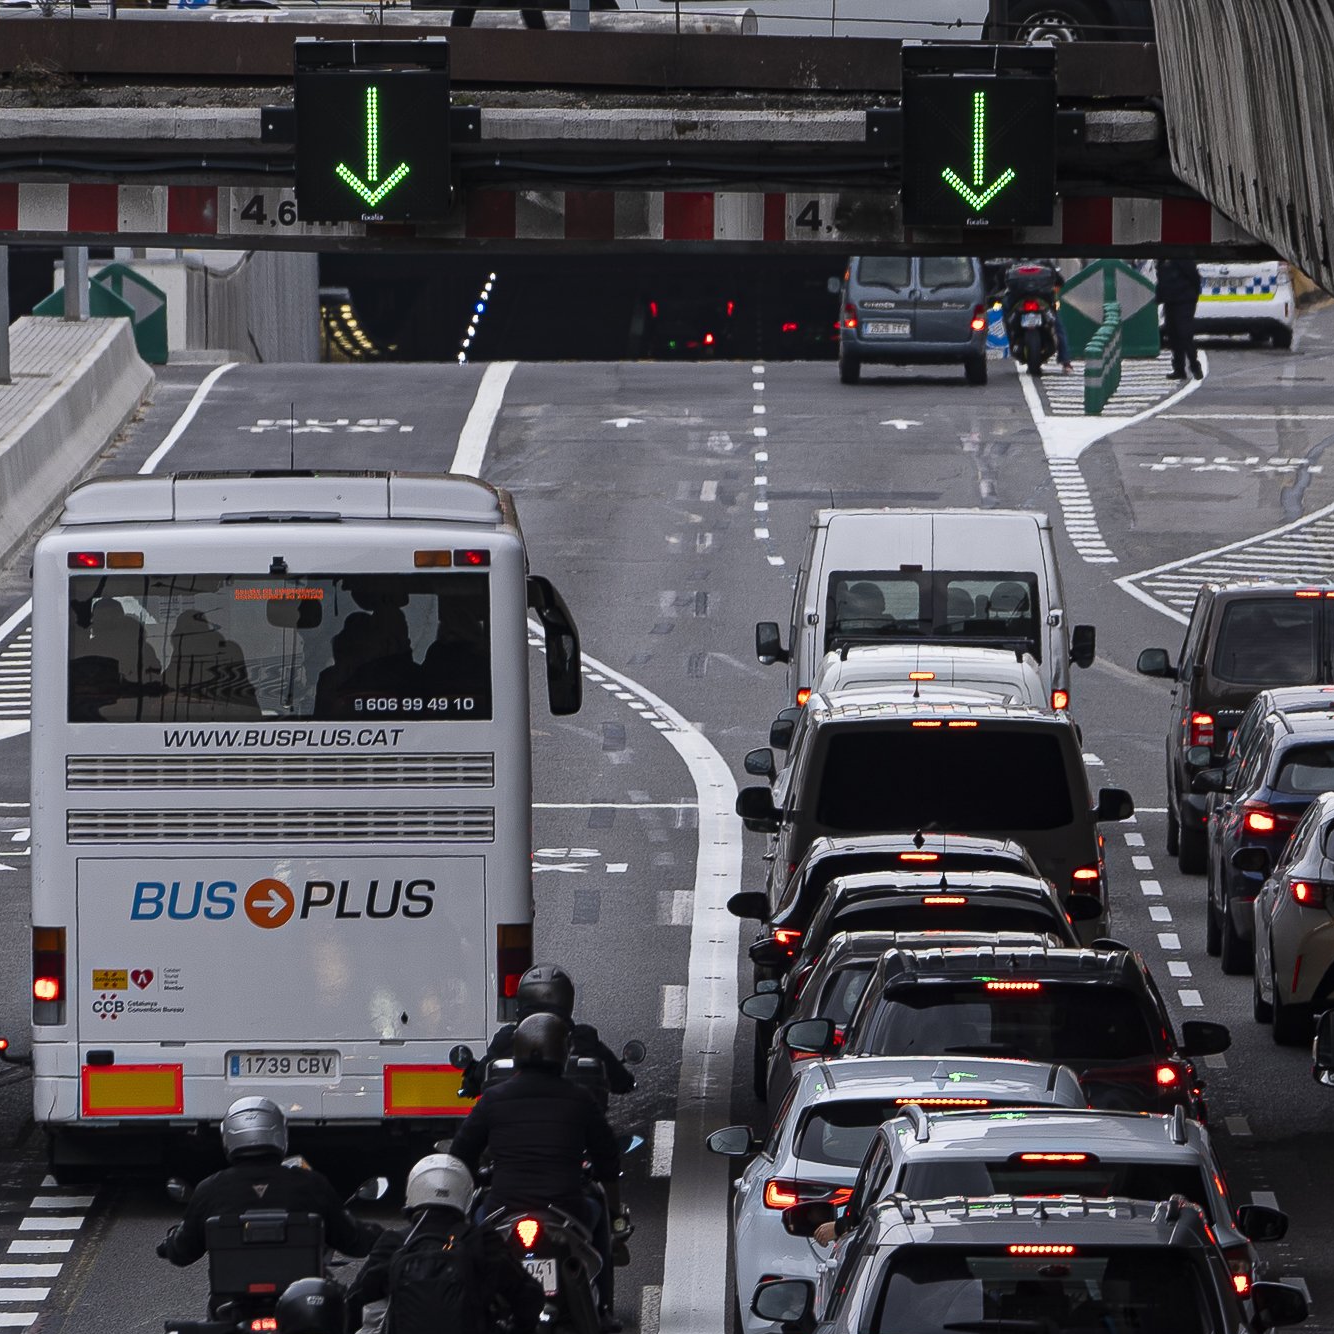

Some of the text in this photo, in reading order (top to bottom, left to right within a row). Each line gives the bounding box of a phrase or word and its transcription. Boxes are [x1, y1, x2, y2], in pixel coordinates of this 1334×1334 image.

[366, 698, 474, 711] 606 99 49 10
[163, 728, 405, 748] WWW.BUSPLUS.CAT
[130, 878, 436, 921] BUS PLUS
[92, 1000, 125, 1013] CCB
[246, 1057, 332, 1074] 1739 CBV
